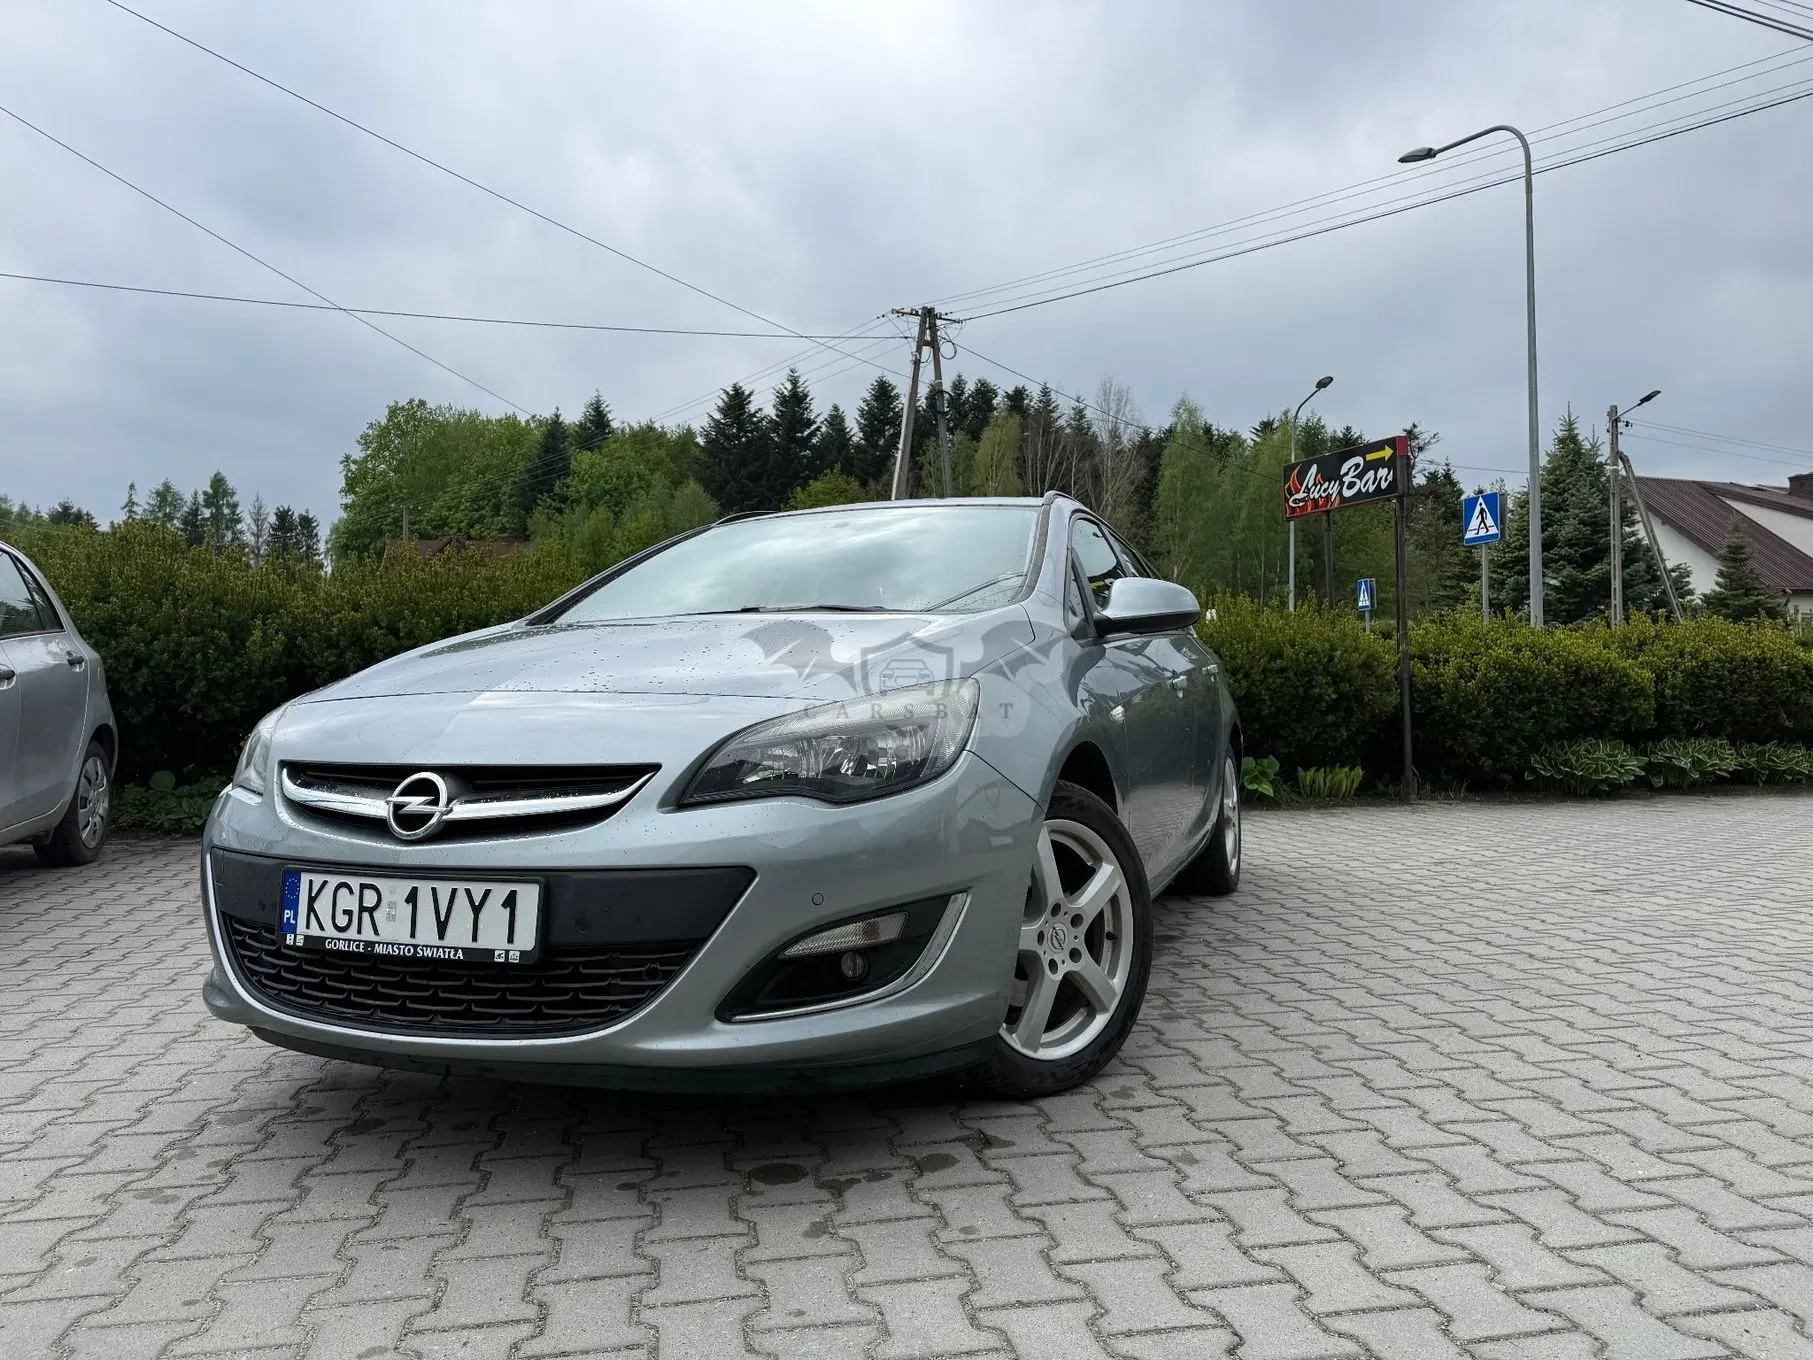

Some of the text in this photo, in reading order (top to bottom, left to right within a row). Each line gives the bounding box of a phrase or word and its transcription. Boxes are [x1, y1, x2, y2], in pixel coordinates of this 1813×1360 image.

[1288, 456, 1394, 507] Lucy Bar
[283, 909, 296, 924] PL
[305, 878, 518, 944] KGR 1VY1
[325, 938, 365, 953] GORLICE
[374, 943, 414, 956] MIASTO
